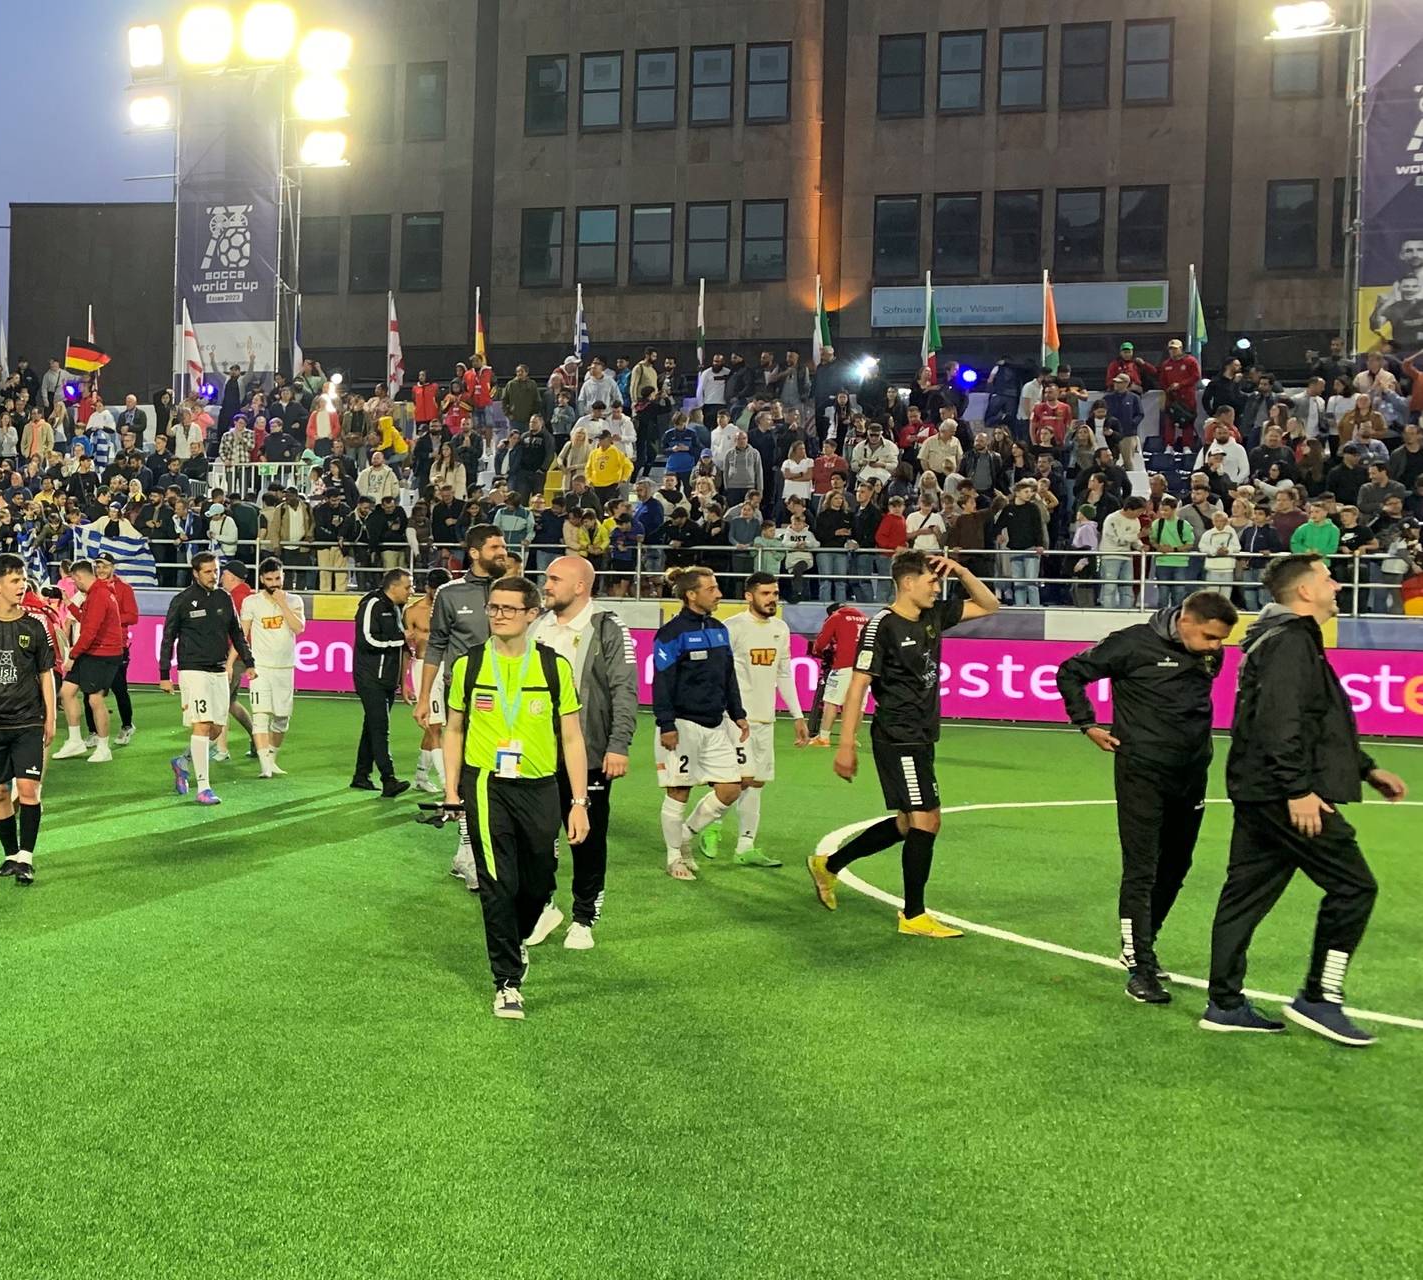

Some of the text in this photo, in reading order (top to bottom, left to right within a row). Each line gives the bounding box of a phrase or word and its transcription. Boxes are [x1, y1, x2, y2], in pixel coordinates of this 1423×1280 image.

[205, 271, 245, 280] socca
[192, 281, 259, 292] world cup
[882, 304, 1005, 314] Software ervice Wissen
[1128, 310, 1163, 319] DATEV
[251, 691, 259, 705] 11
[194, 699, 207, 714] 13
[736, 747, 747, 764] 5
[679, 755, 689, 773] 2
